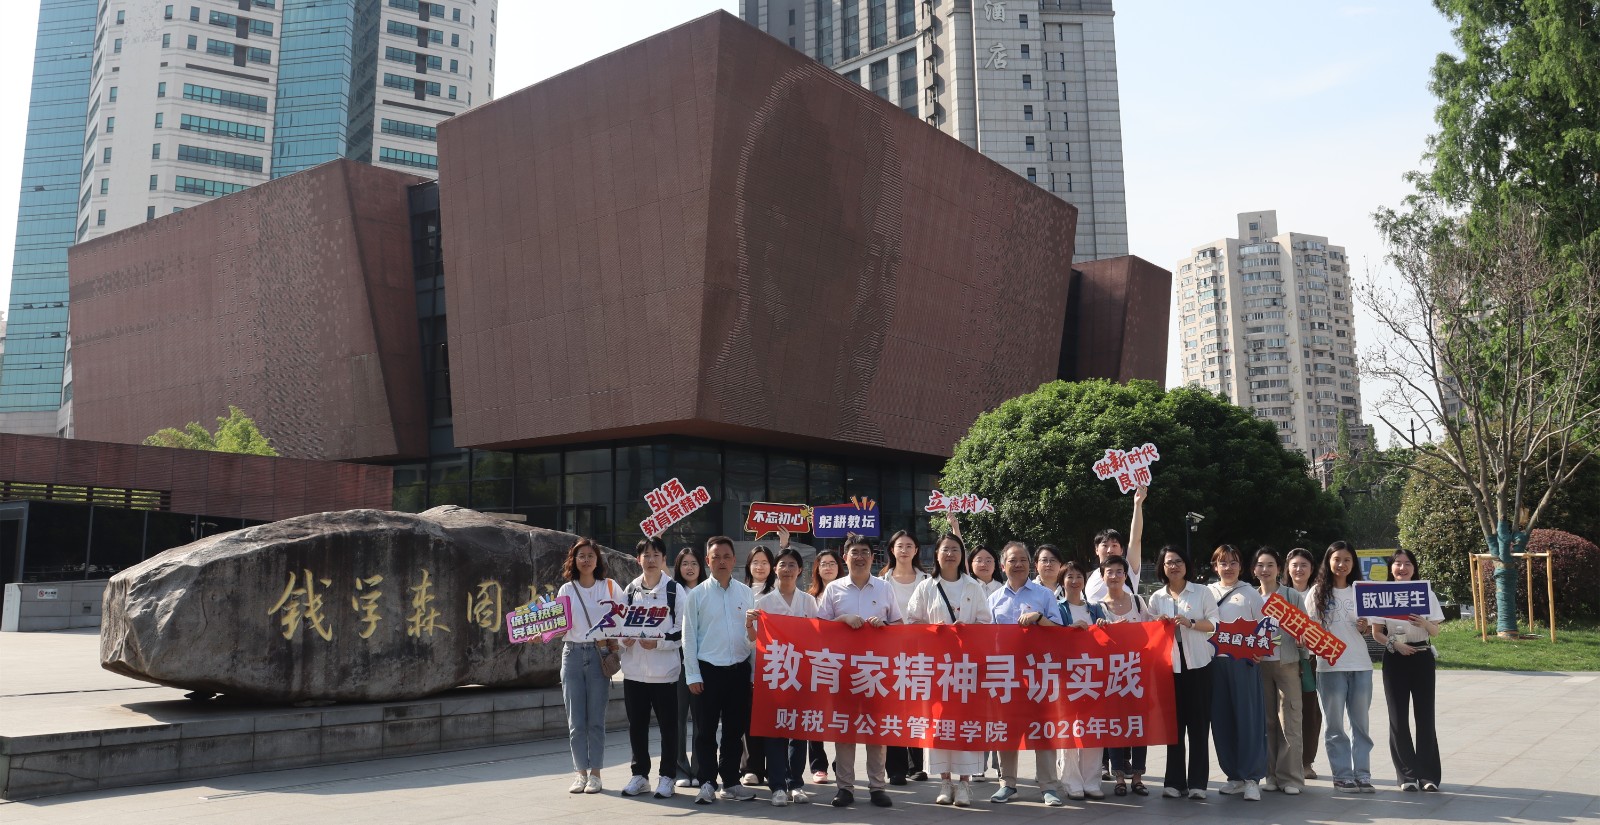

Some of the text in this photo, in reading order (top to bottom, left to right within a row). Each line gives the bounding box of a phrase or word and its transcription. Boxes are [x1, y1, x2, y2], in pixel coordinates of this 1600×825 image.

[984, 0, 1008, 70] 酒店
[1095, 445, 1158, 478] 做新时代
[1118, 466, 1150, 491] 良师
[646, 479, 685, 513] 弘扬
[926, 491, 993, 513] 立德树人
[642, 488, 709, 536] 教育家精神
[752, 510, 804, 526] 不忘初心
[818, 514, 876, 529] 躬耕教坛
[267, 568, 556, 641] 钱学森图
[1361, 590, 1427, 609] 敬业爱生
[510, 603, 564, 627] 保持热爱
[512, 615, 567, 639] 奔赴山海
[623, 606, 668, 628] 追梦
[1217, 631, 1270, 650] 强国有我
[1264, 596, 1344, 664] 奋进有我
[762, 639, 1145, 704] 教育家精神寻访实践
[774, 708, 1145, 743] 财税与公共管理学院 2026年5月
